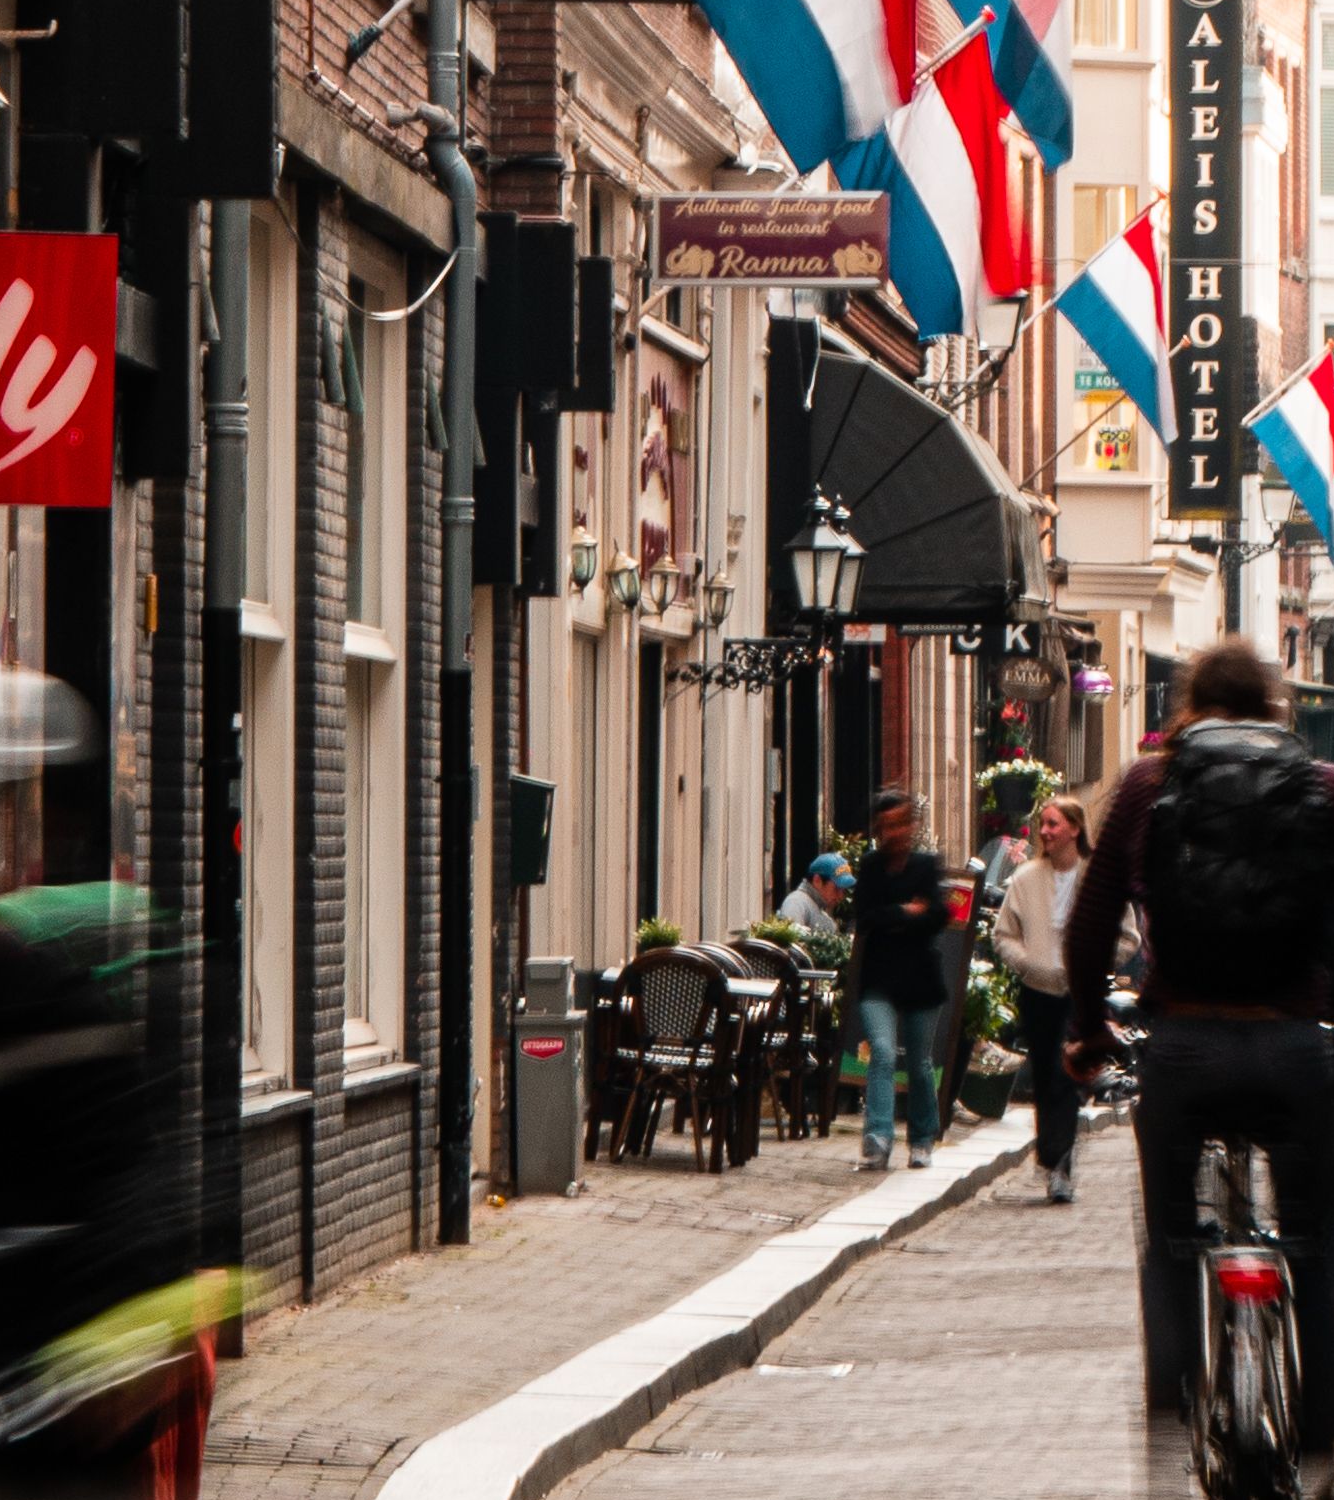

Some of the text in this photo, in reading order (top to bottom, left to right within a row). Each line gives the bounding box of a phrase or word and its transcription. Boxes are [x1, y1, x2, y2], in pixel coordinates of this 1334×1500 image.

[674, 197, 875, 218] Authentic Indian food
[717, 219, 831, 235] in restaurant
[719, 245, 829, 278] Ramna
[1095, 374, 1120, 388] KOO
[1188, 266, 1223, 490] HOTEL
[1004, 669, 1052, 684] EMMA
